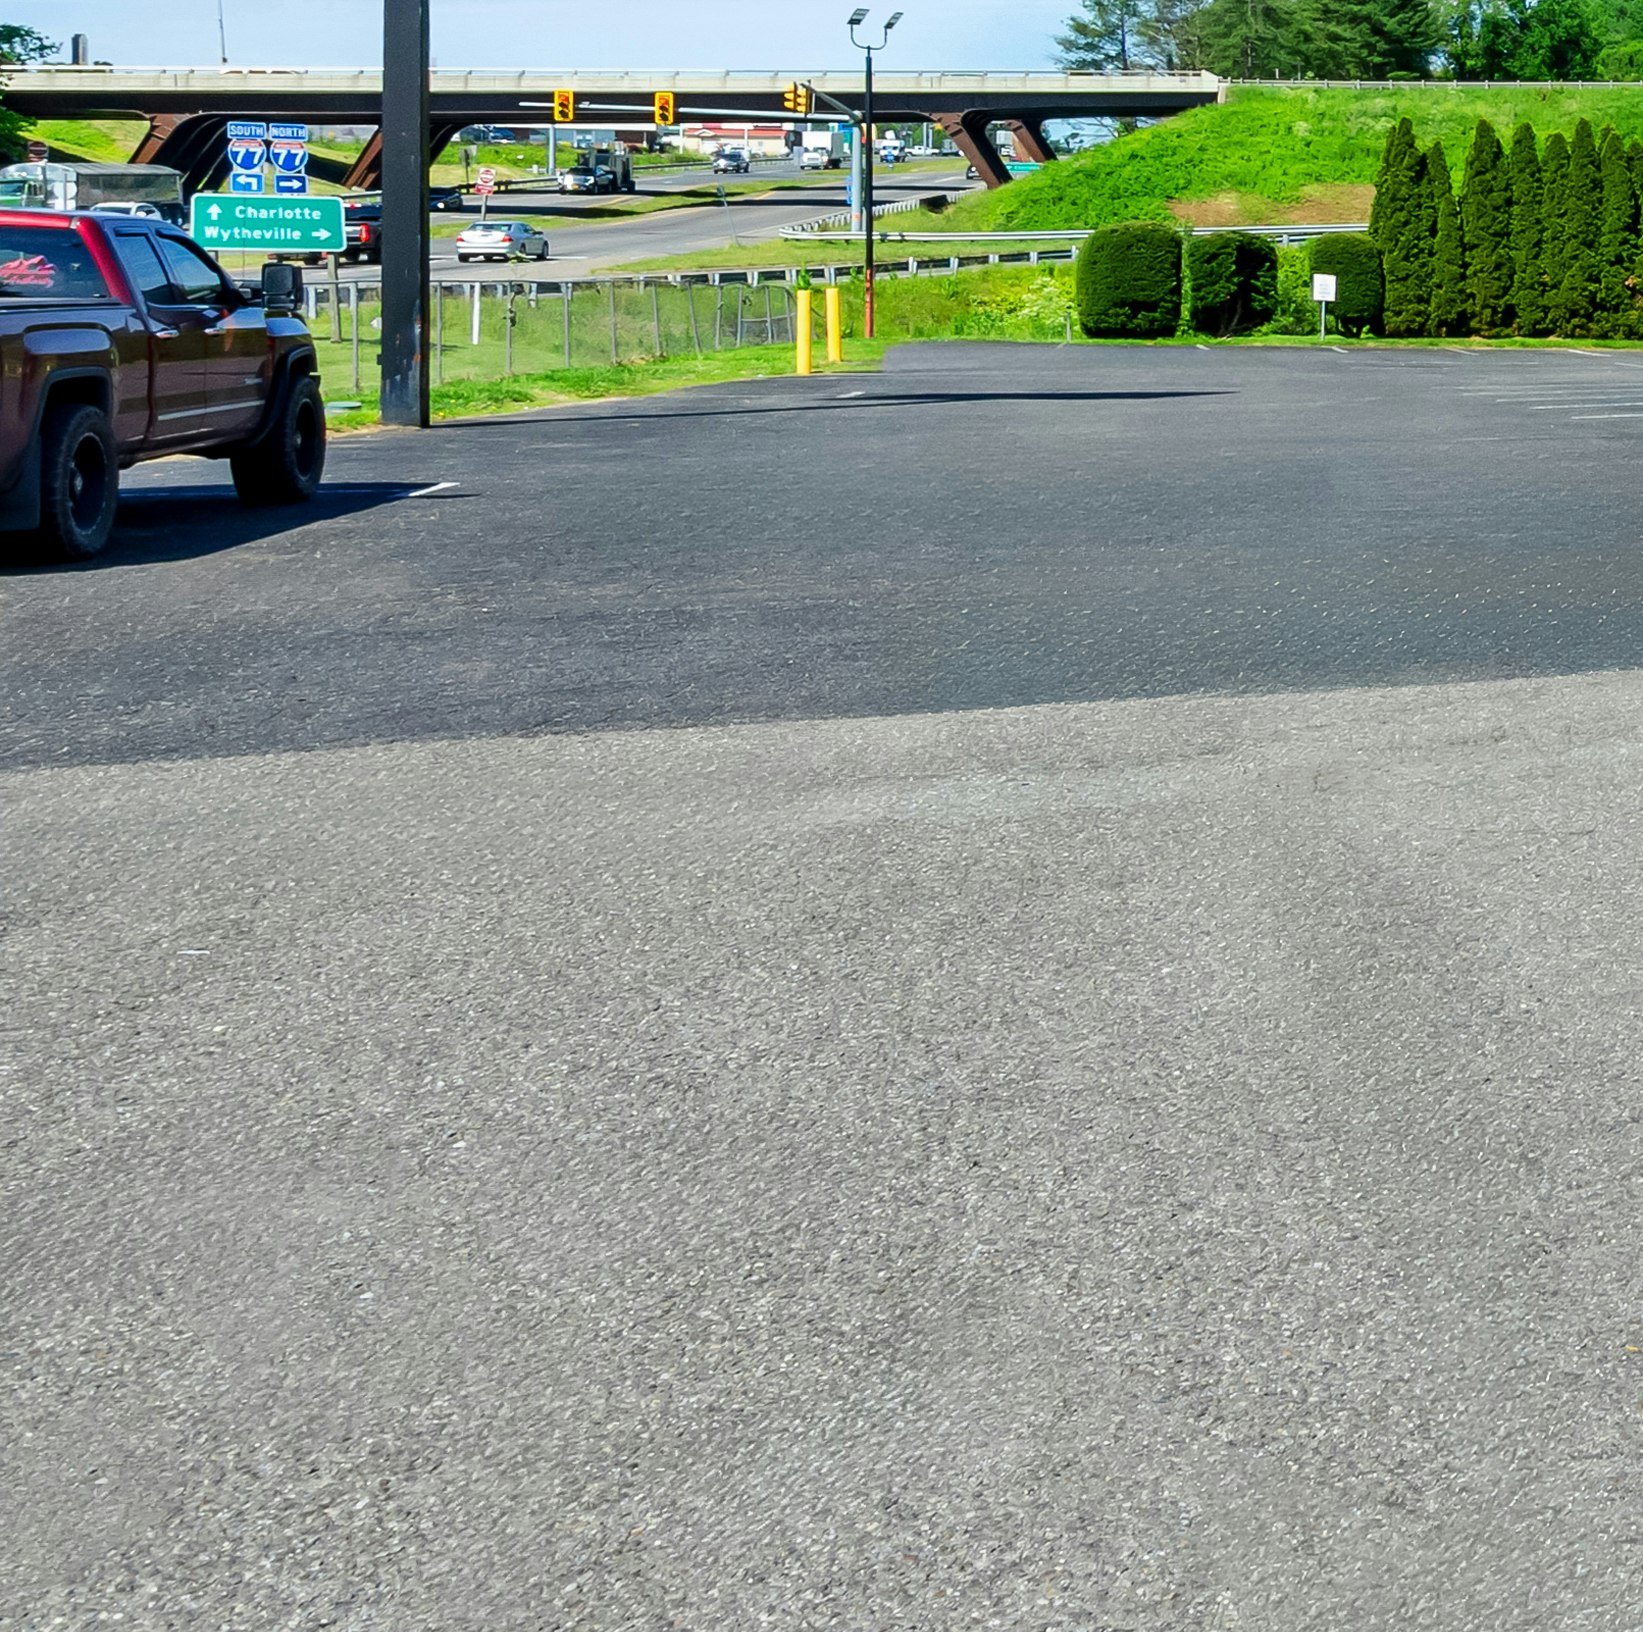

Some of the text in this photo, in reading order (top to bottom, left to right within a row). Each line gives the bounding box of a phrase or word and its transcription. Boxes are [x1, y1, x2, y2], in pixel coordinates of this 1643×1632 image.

[230, 125, 264, 136] SOUTH
[271, 127, 306, 137] NORTH
[231, 147, 264, 165] 77
[273, 149, 305, 167] 77
[235, 205, 322, 220] Charlotte
[204, 226, 302, 242] Wytheville
